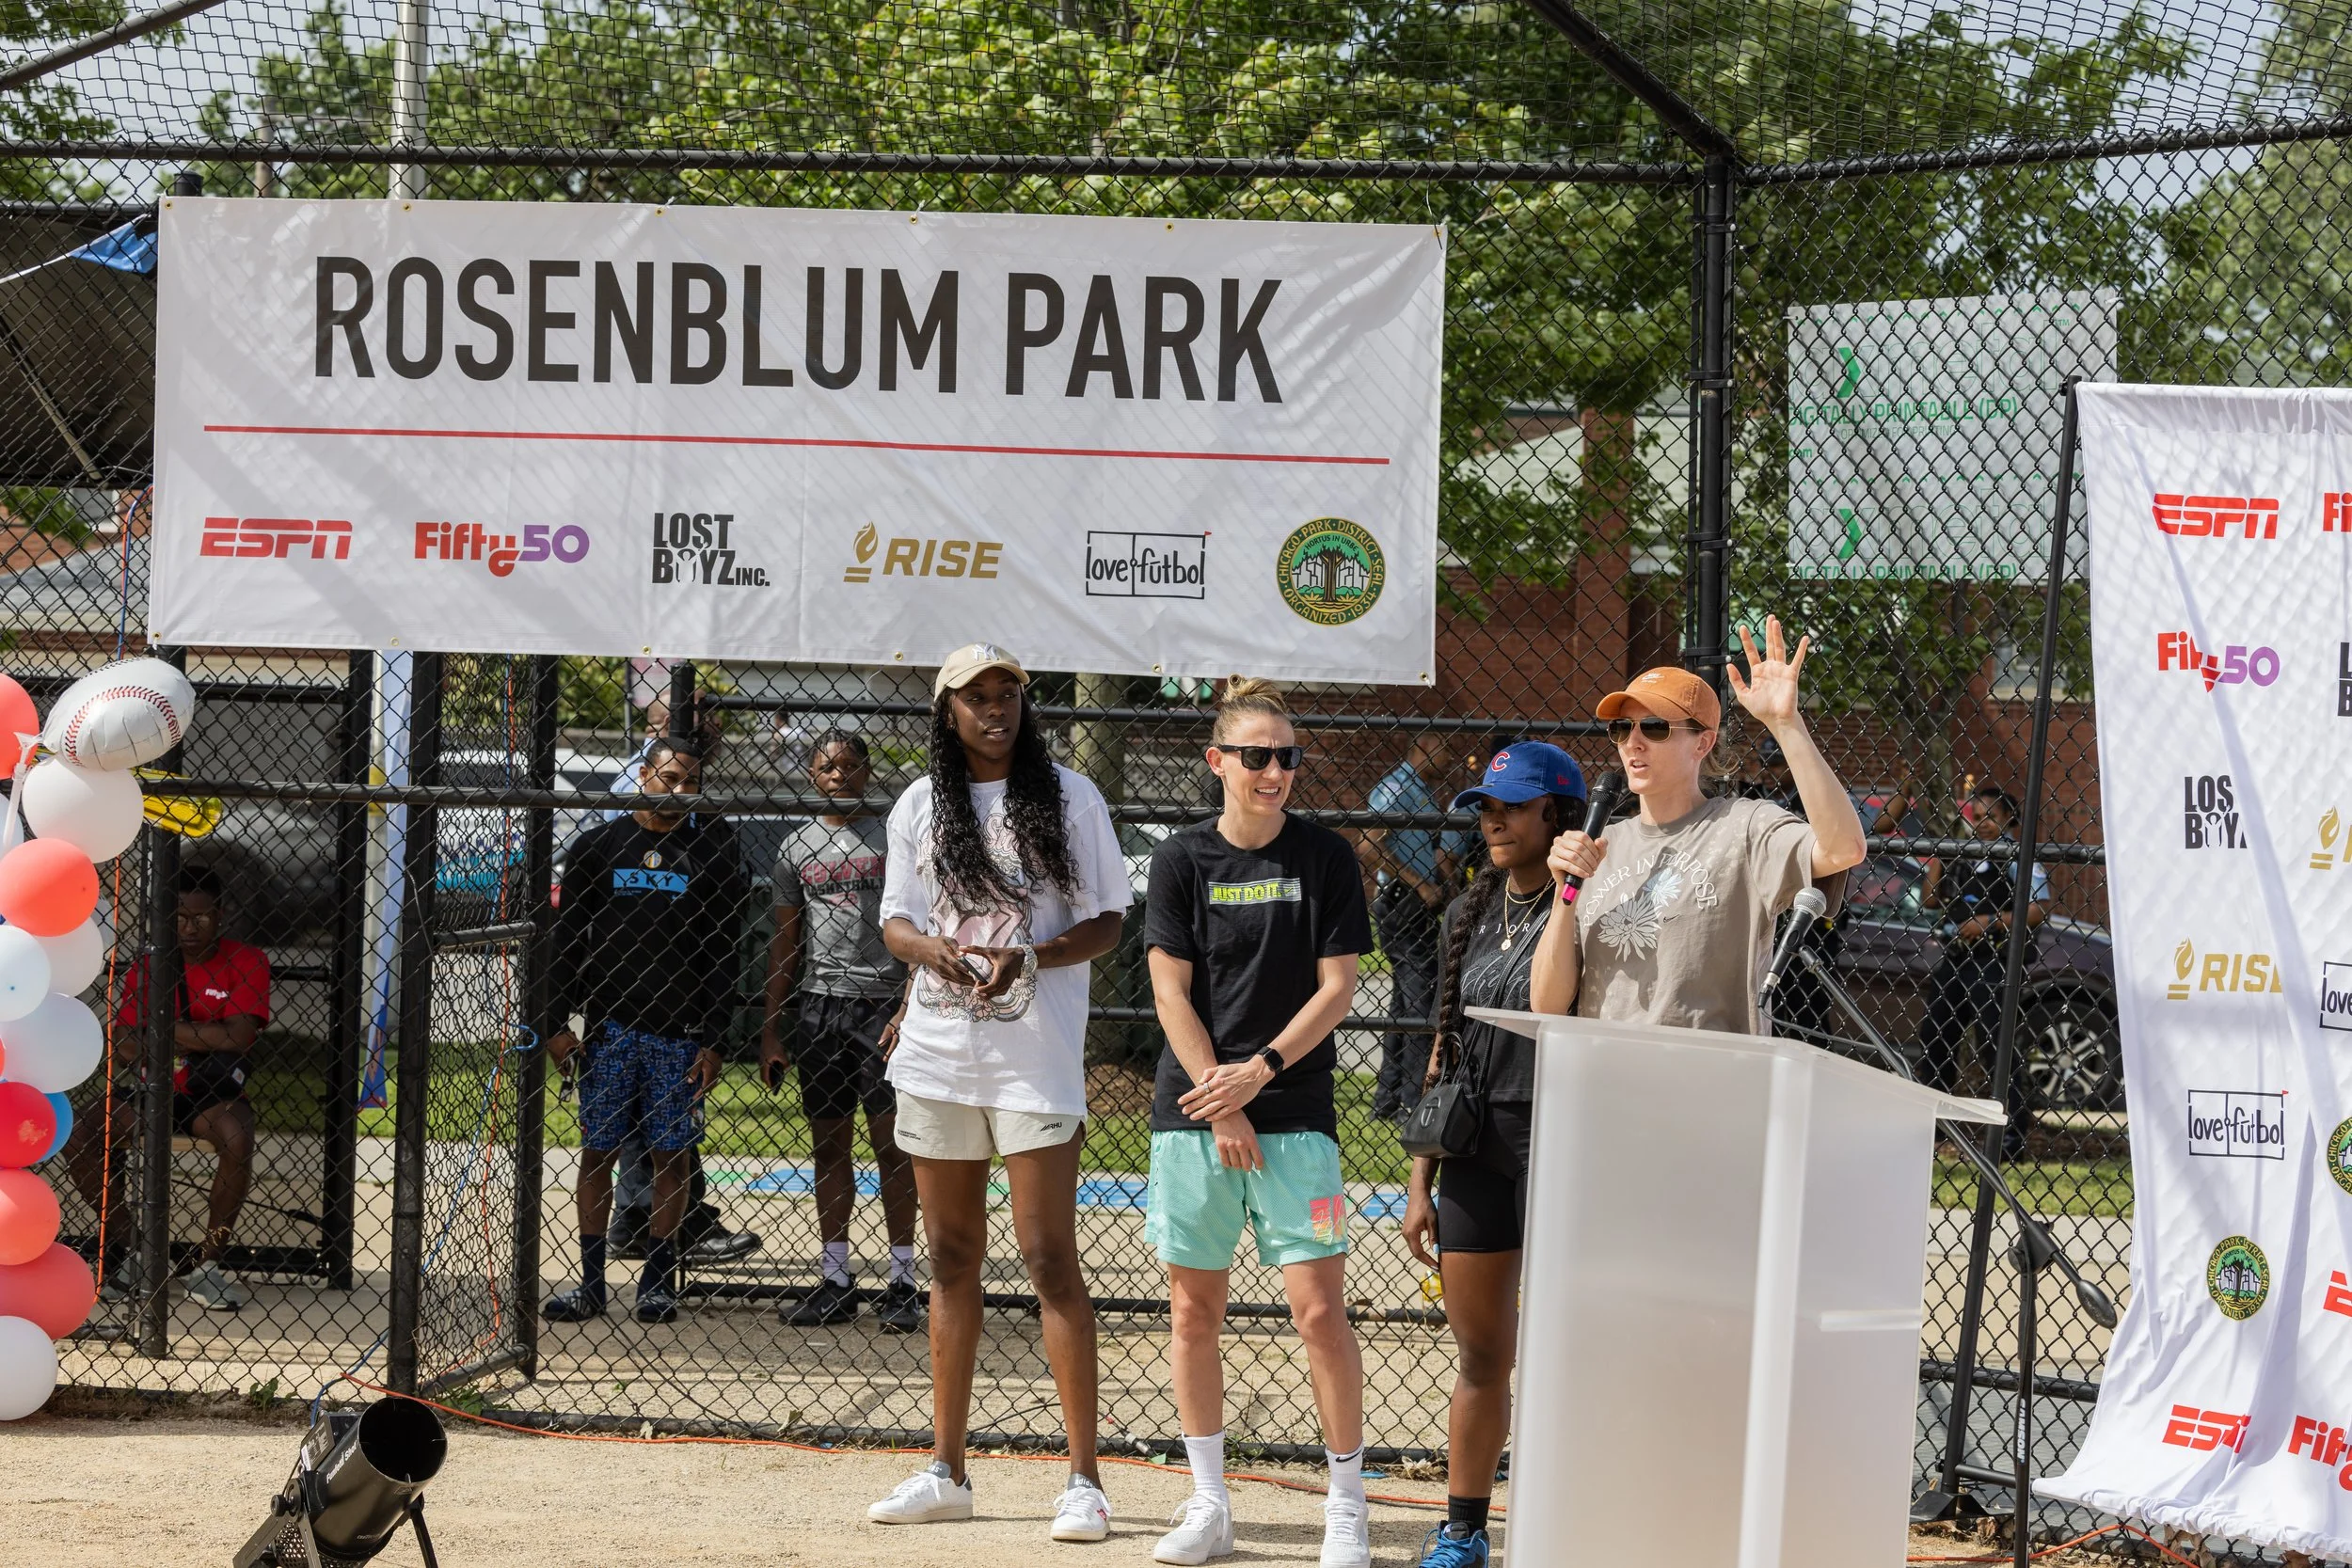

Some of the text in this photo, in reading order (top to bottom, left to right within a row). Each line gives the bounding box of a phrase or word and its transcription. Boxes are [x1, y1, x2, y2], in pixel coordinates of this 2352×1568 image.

[315, 256, 1282, 404] ROSENBLUM PARK
[653, 513, 735, 550] LOST
[2153, 493, 2280, 539] ESPN
[199, 517, 353, 560] ESPN
[414, 521, 590, 578] Fifty50
[882, 538, 1004, 579] RISE
[1279, 519, 1384, 586] CHICAGO PARK DISTRICT SEAL
[1305, 534, 1331, 550] HORTUS
[652, 547, 771, 587] BOYZ INC.
[1086, 546, 1128, 582] love
[1283, 588, 1377, 624] ORGANIZED 1934
[1491, 751, 1511, 772] C
[2185, 774, 2235, 814] LOS
[629, 872, 674, 887] SKY
[1212, 881, 1282, 902] JUST DO IT.
[1582, 865, 1631, 927] POWER
[1635, 855, 1656, 875] IN
[2188, 1104, 2224, 1142] love
[2328, 1124, 2348, 1163] CHICAGO
[2207, 1248, 2221, 1287] CHICAGO
[2220, 1237, 2240, 1251] PARK
[2261, 1268, 2269, 1291] SEAL
[2248, 1294, 2265, 1315] 1934
[2016, 1398, 2026, 1459] SAMSON
